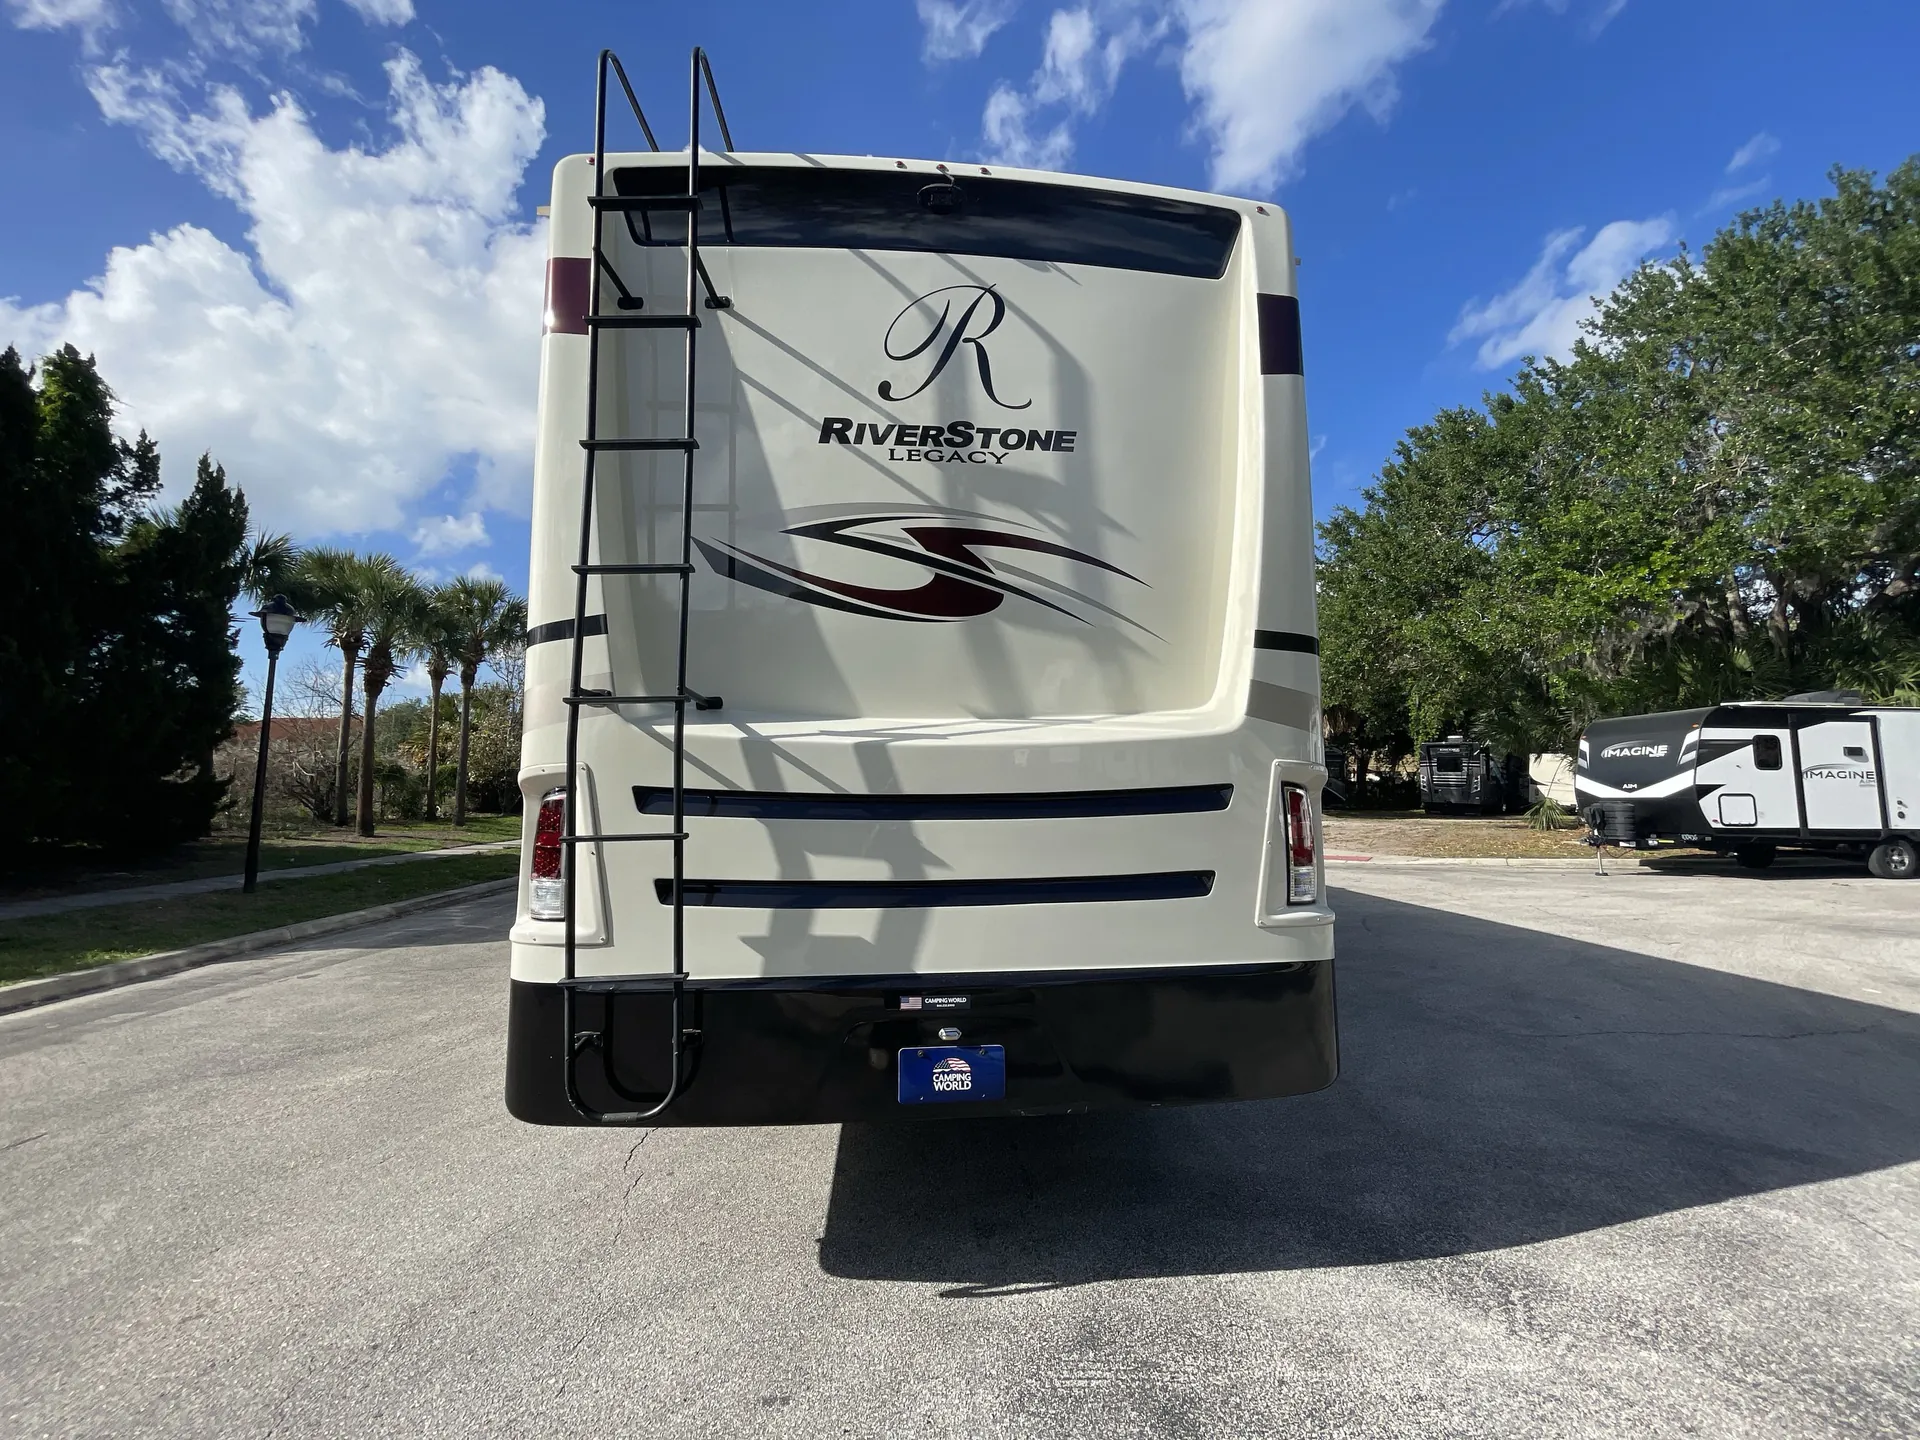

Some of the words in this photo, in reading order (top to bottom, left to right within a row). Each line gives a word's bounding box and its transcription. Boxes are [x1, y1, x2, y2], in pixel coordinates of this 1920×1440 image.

[877, 283, 1032, 410] R
[888, 448, 1010, 465] LEGACY
[1604, 744, 1669, 758] IMAGINE
[1803, 770, 1876, 780] IMAGINE
[932, 1073, 972, 1082] CAMPING
[933, 1080, 972, 1092] WORLD
